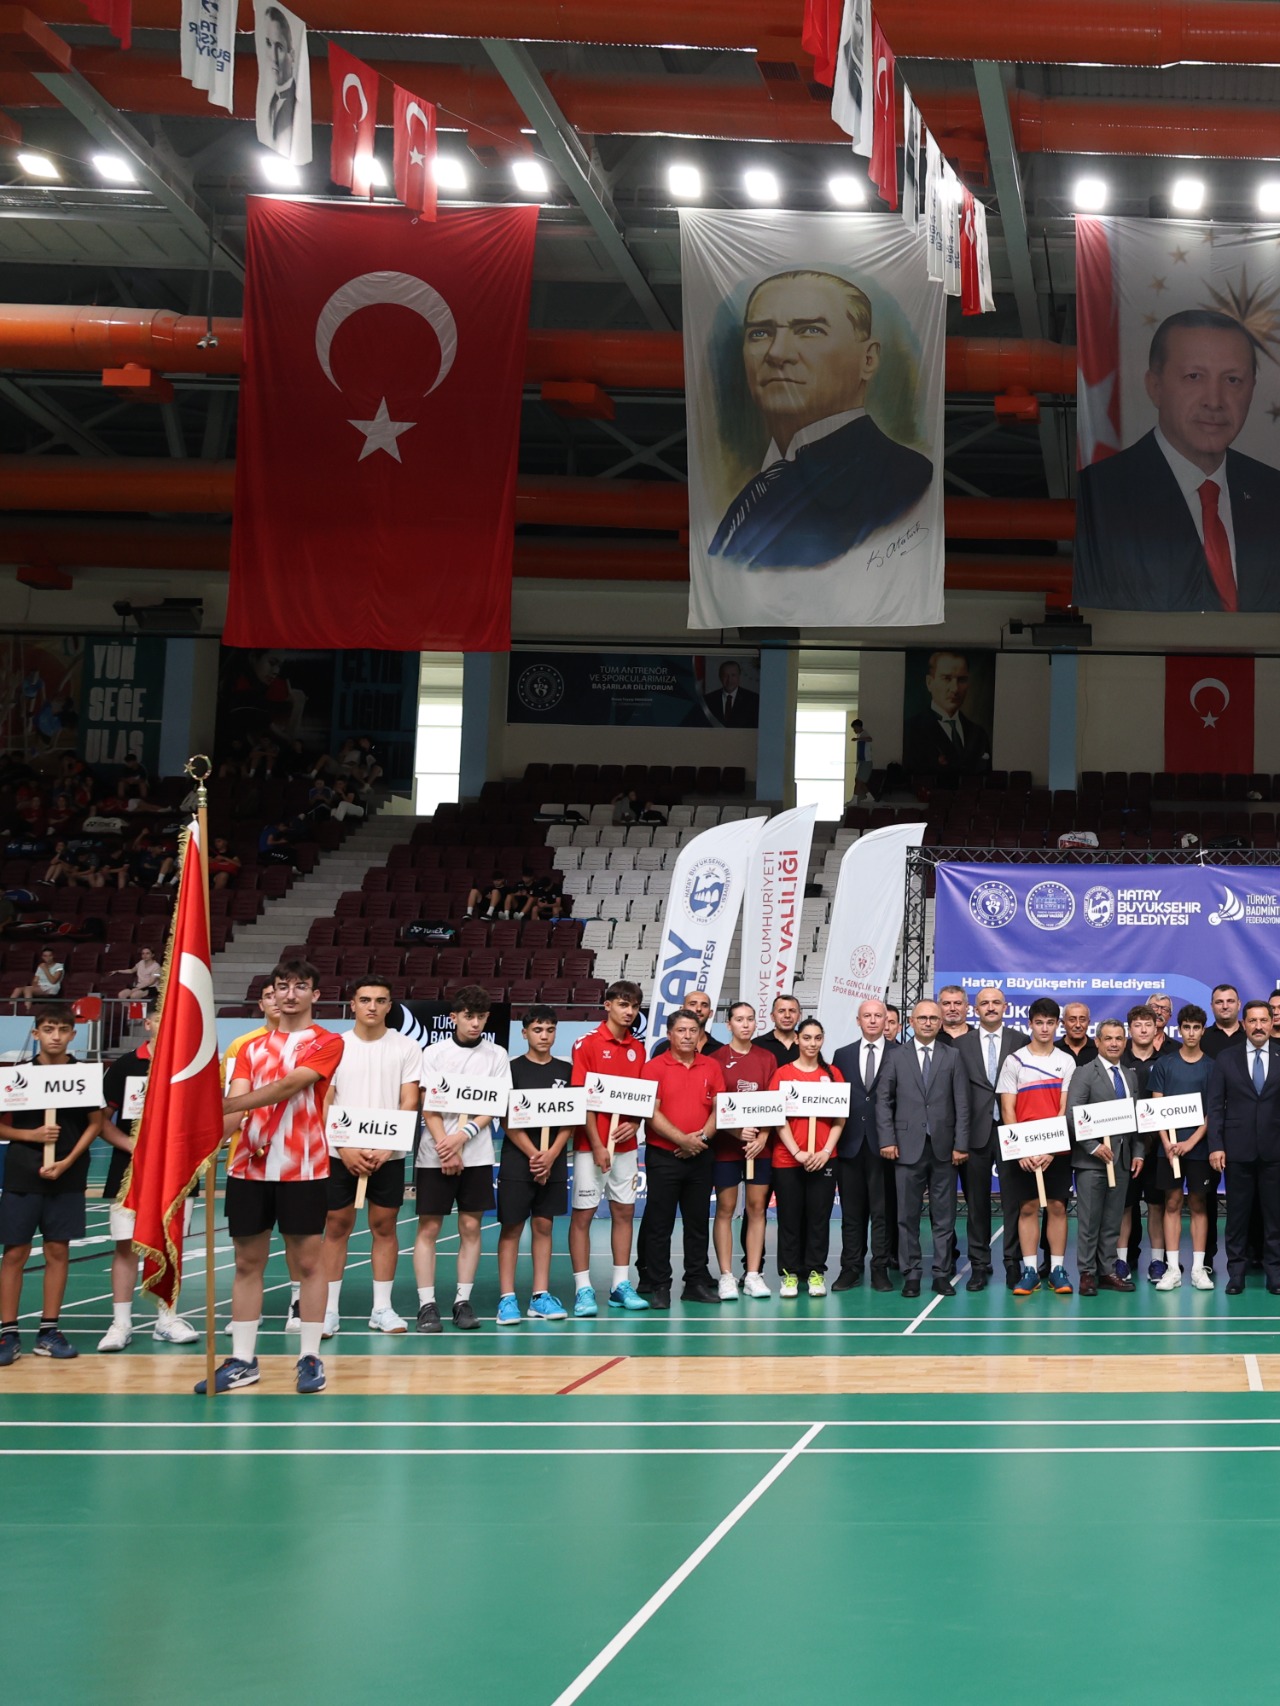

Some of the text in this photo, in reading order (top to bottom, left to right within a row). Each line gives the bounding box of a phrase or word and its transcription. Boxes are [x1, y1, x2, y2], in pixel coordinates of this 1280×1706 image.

[778, 850, 798, 952] VALİLİĞİ
[1118, 890, 1162, 900] HATAY
[1246, 893, 1277, 906] TÜRKİYE
[760, 852, 775, 965] CUMHURİYETİ
[1118, 900, 1201, 914] BÜYÜKŞEHİR
[1118, 913, 1188, 926] BELEDİYESİ
[874, 986, 882, 994] VE
[962, 976, 1166, 990] Hatay Büyükşehir Belediyesi
[44, 1079, 86, 1095] MUŞ
[456, 1086, 498, 1102] IĞDIR
[610, 1090, 652, 1102] BAYBURT
[802, 1094, 848, 1104] ERZİNCAN
[538, 1101, 574, 1113] KARS
[742, 1102, 783, 1114] TEKİRDAĞ
[1160, 1104, 1198, 1119] ÇORUM
[358, 1120, 398, 1136] KİLİS
[1024, 1129, 1065, 1143] ESKİŞEHİR
